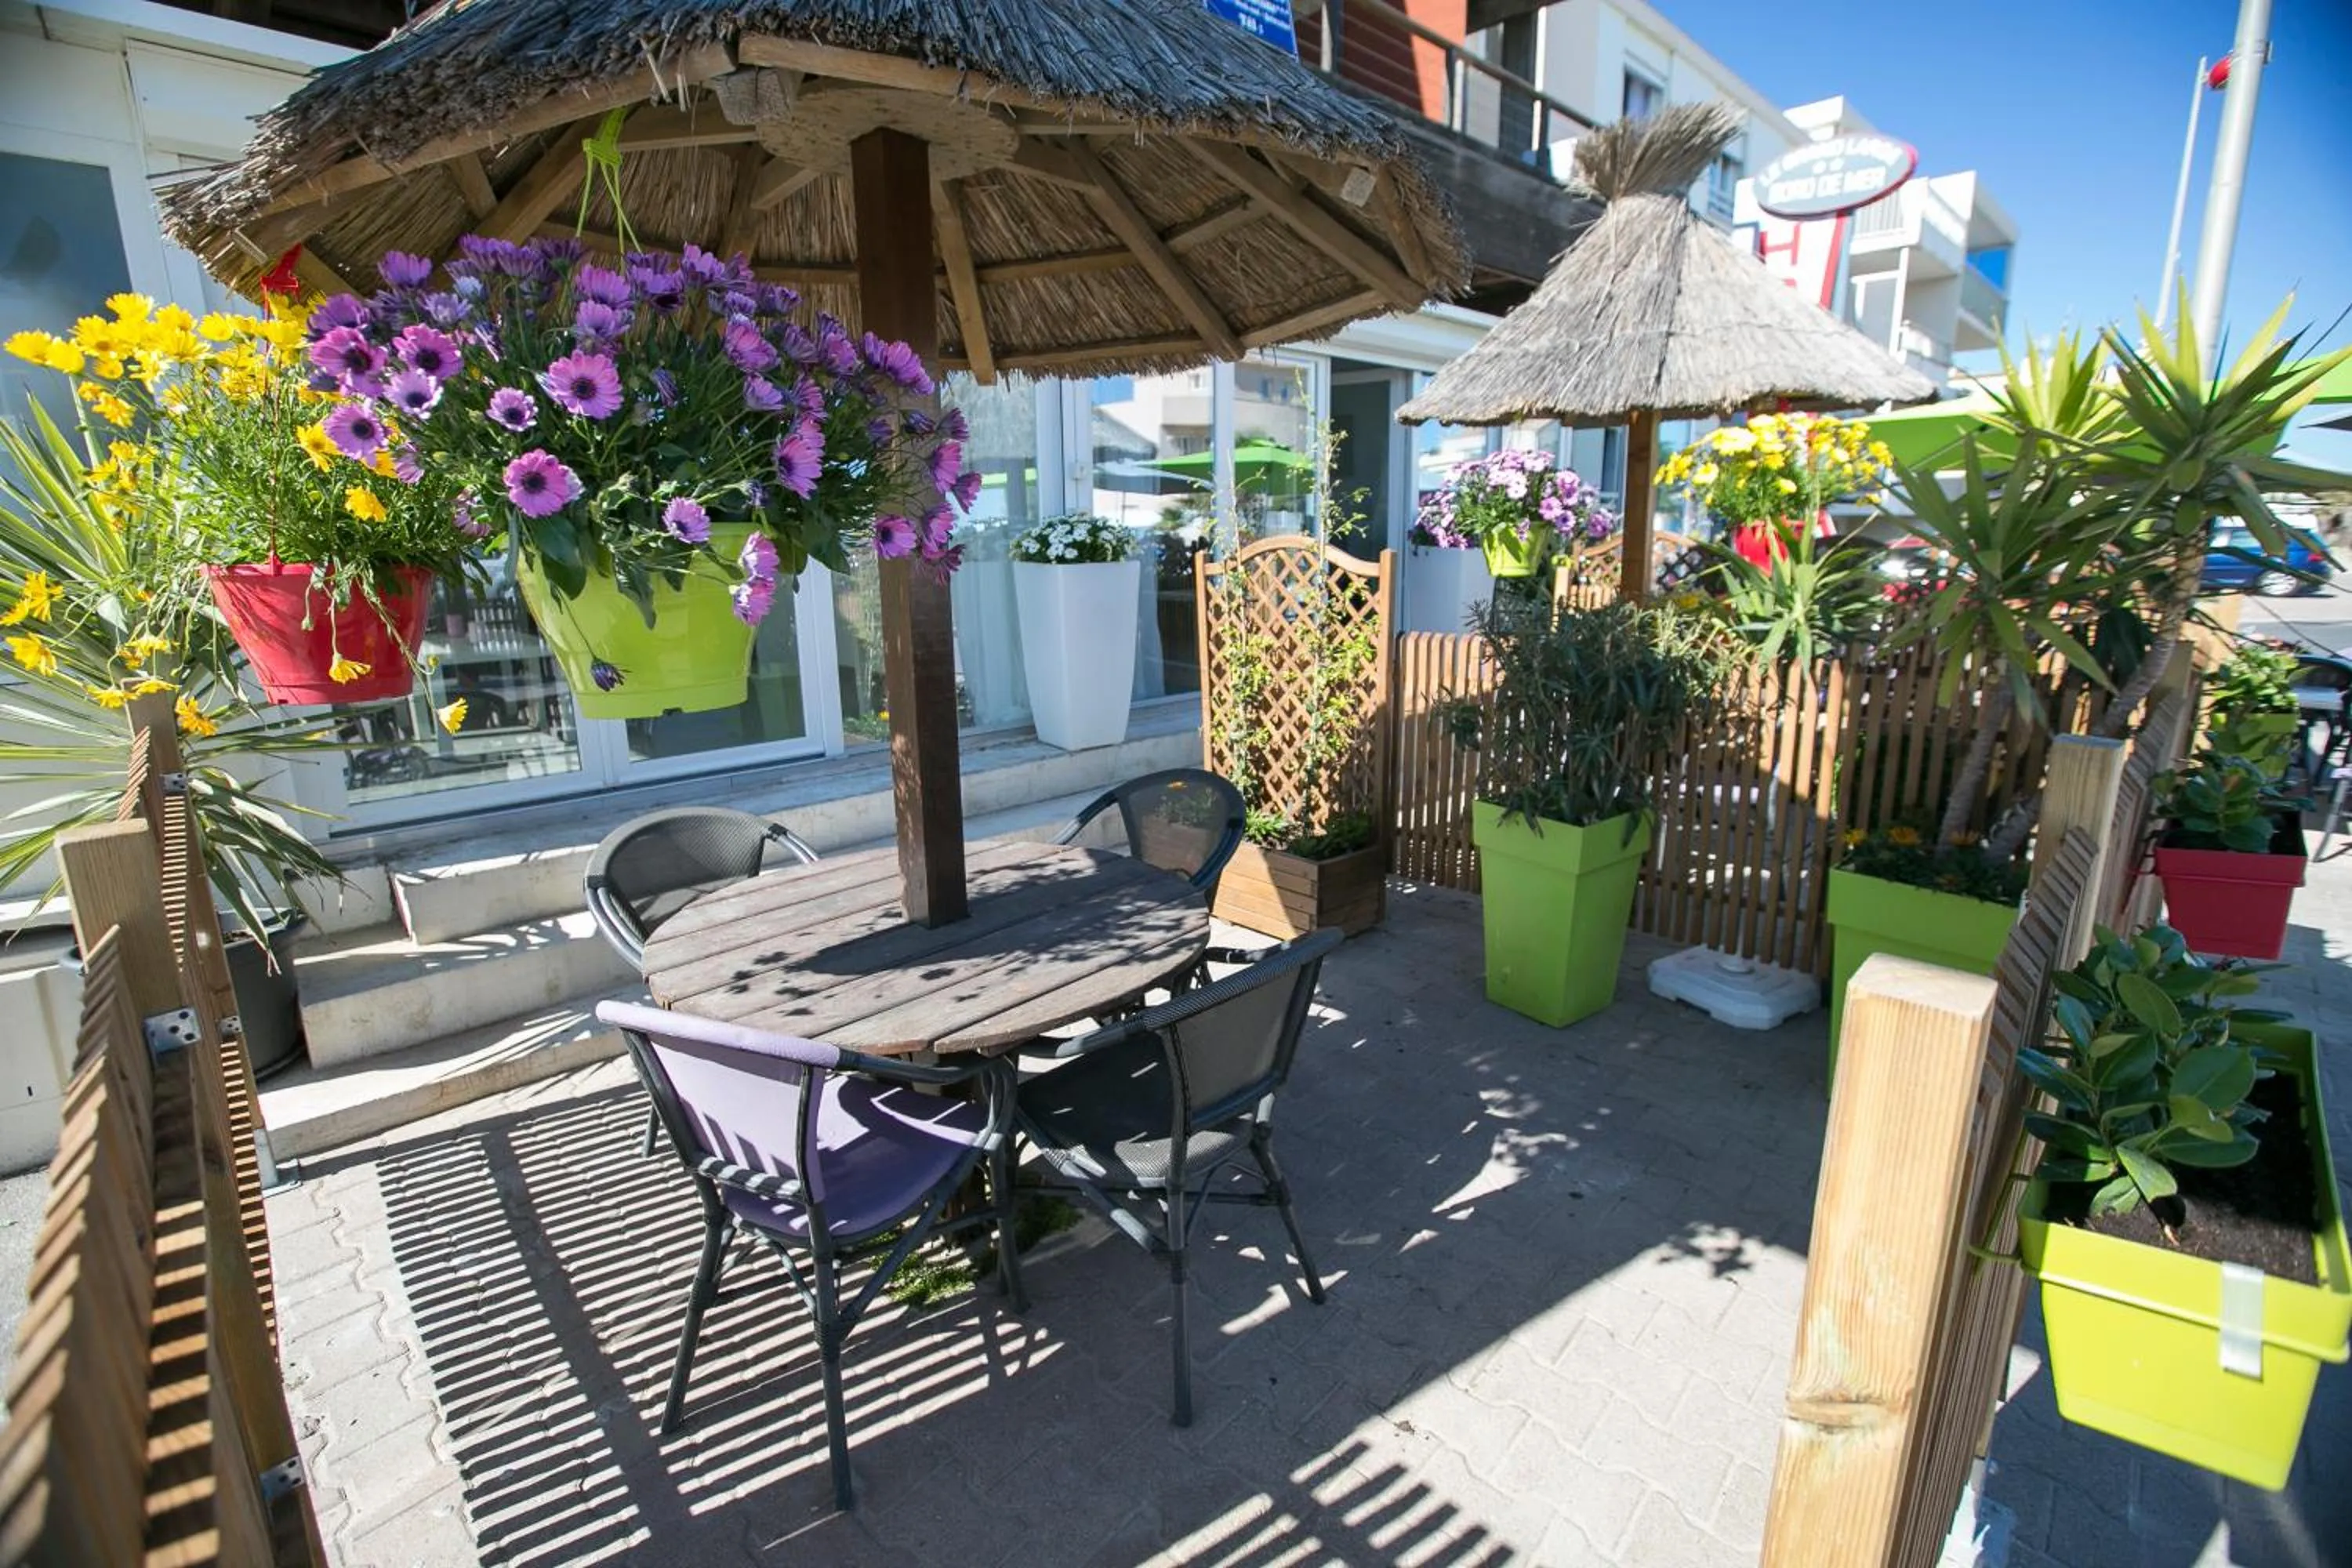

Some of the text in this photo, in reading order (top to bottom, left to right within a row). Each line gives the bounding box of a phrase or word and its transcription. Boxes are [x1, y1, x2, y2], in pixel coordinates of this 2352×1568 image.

[1769, 167, 1886, 205] BORD DE MER
